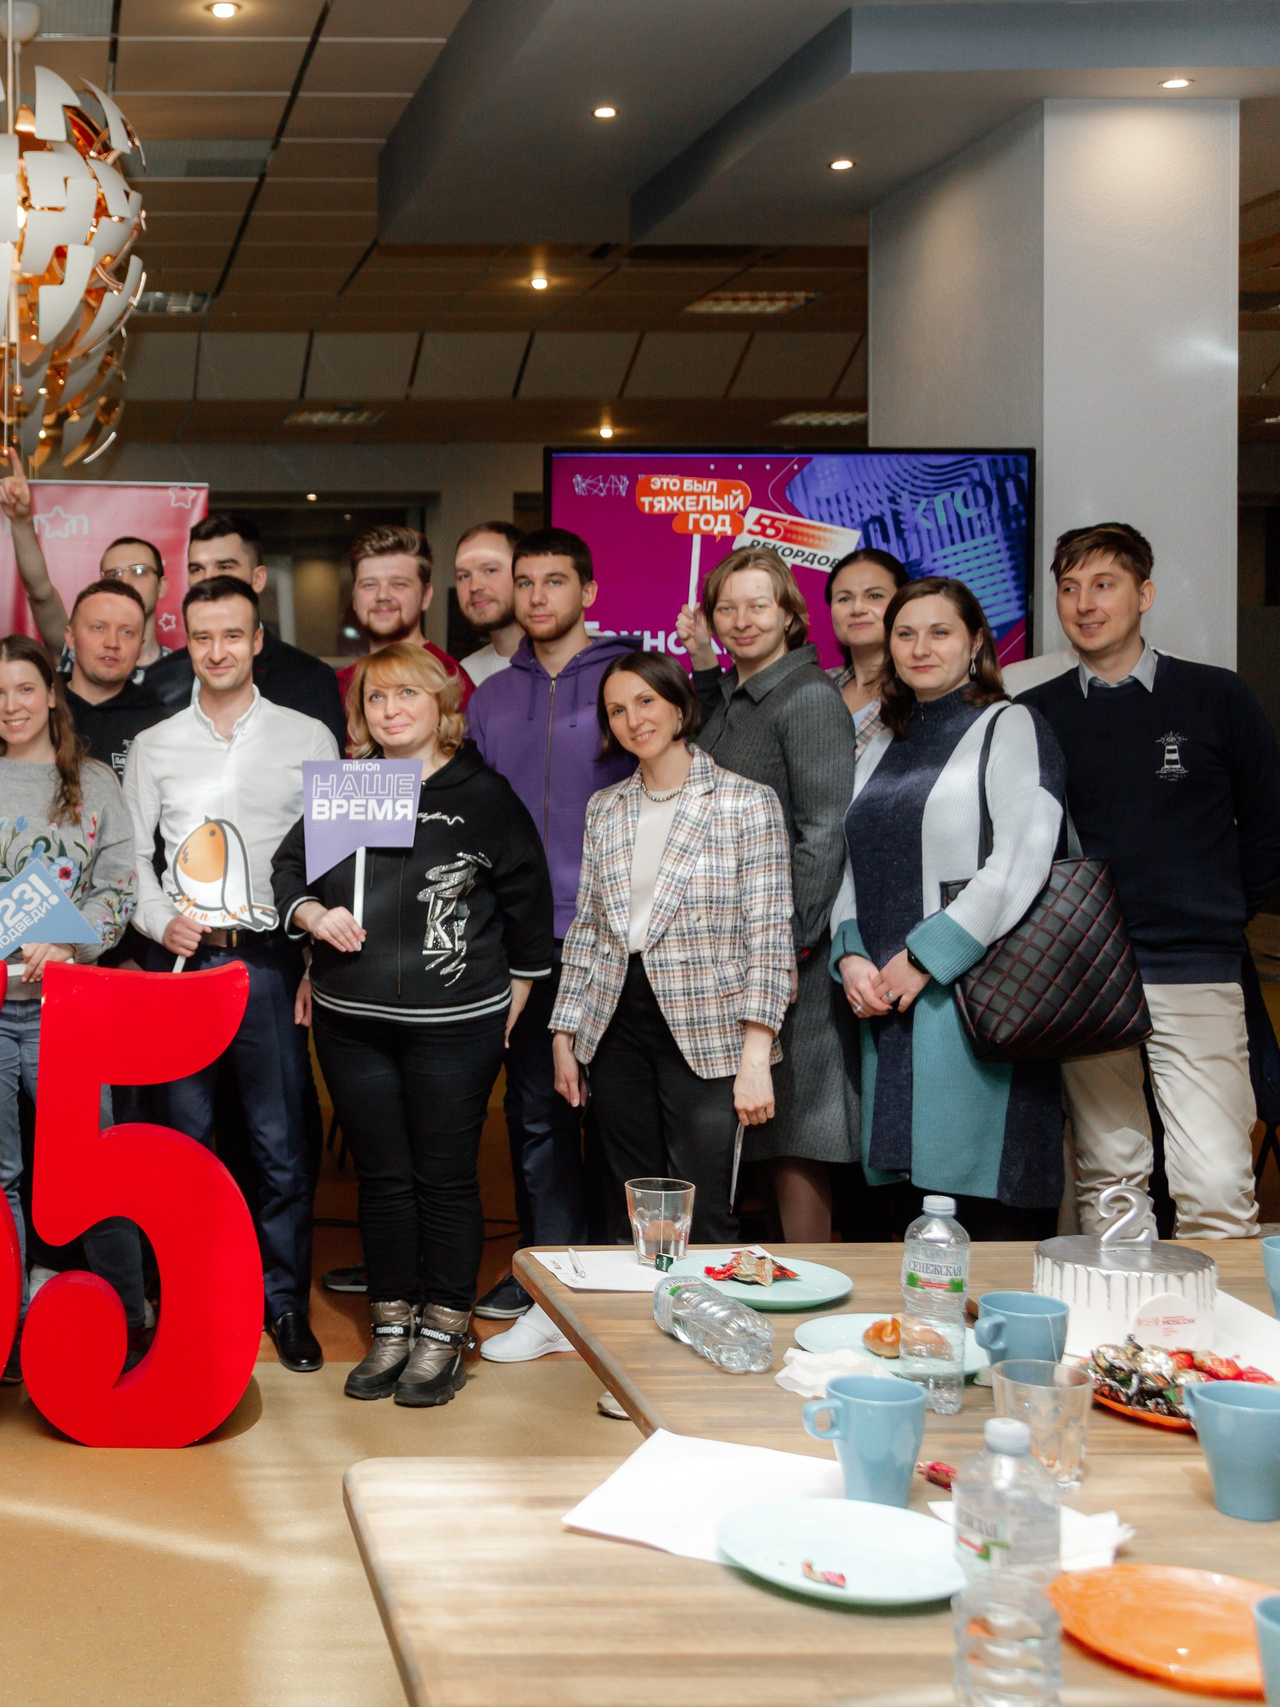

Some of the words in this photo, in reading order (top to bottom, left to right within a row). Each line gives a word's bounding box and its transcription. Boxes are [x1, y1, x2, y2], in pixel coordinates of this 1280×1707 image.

[650, 477, 681, 491] ЭТО
[683, 479, 718, 494] БЫЛ
[640, 489, 744, 513] ТЯЖЕЛЫЙ
[688, 513, 732, 535] ГОД
[342, 761, 380, 772] mikron
[312, 774, 415, 799] НАШЕ
[311, 798, 414, 821] ВРЕМЯ
[908, 1260, 962, 1277] СЕНЕЖСКАЯ
